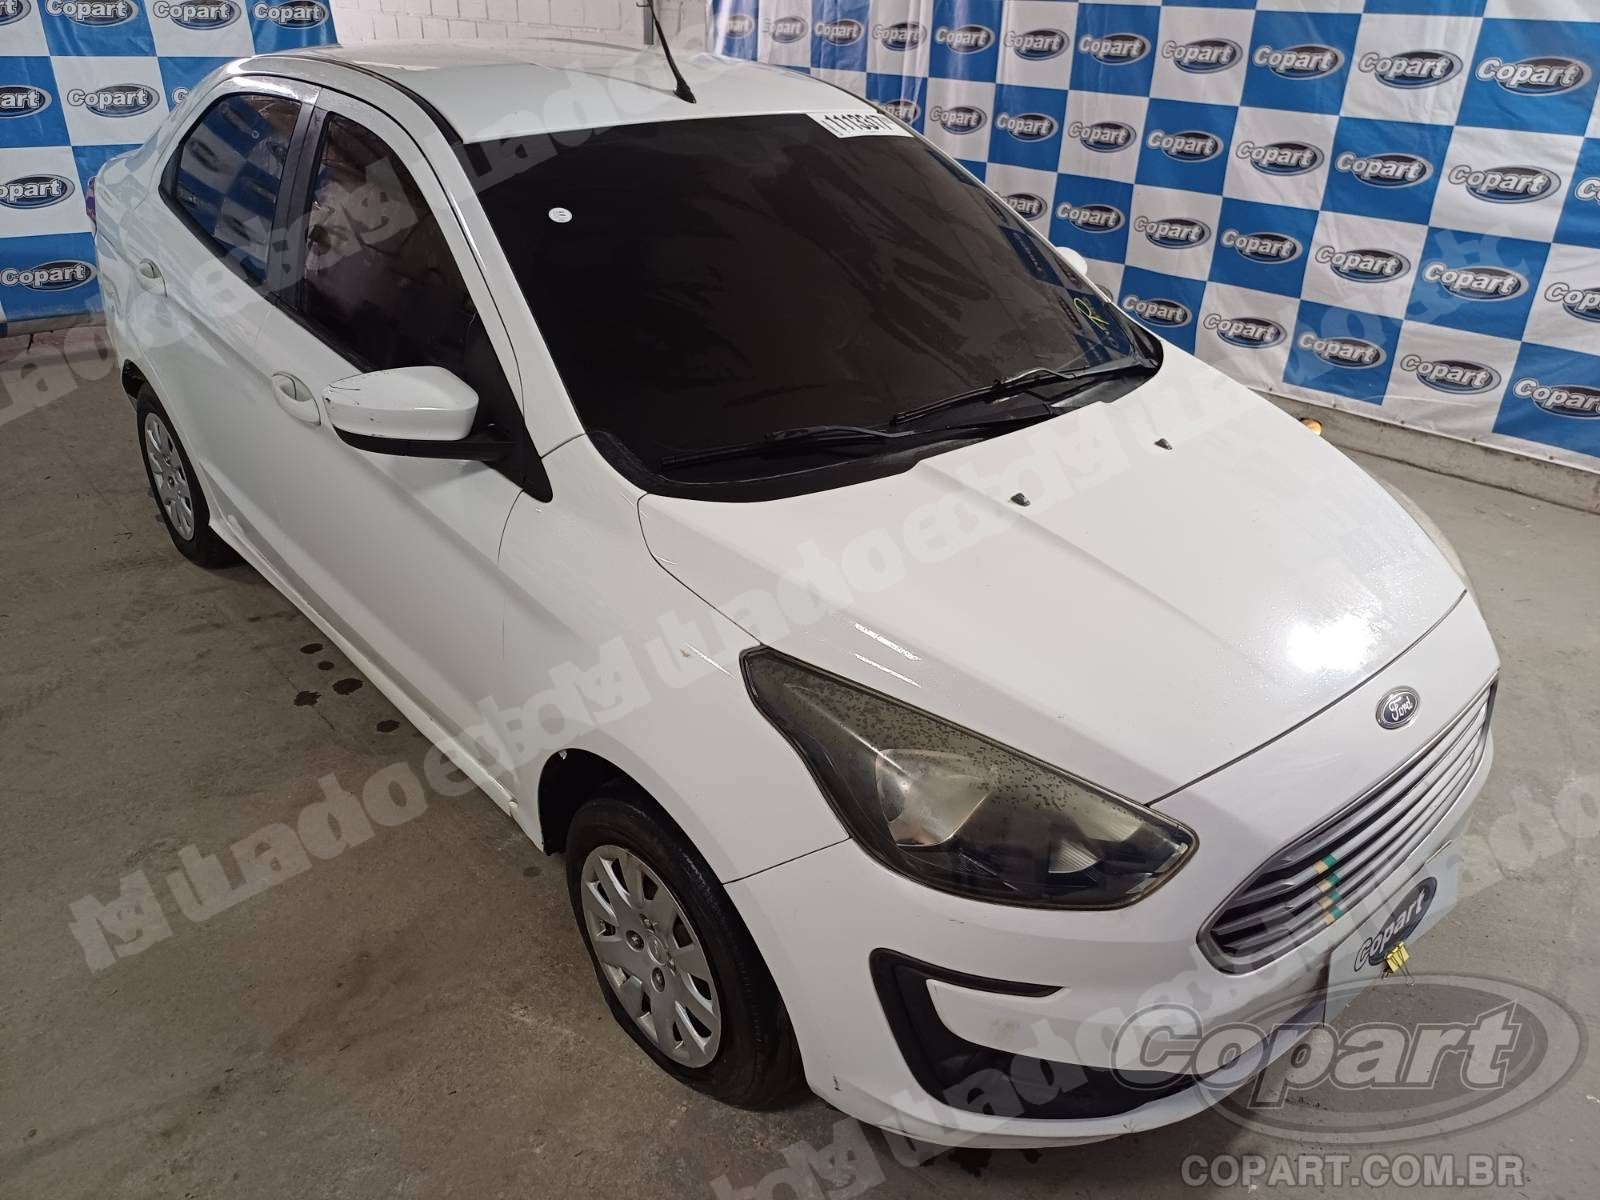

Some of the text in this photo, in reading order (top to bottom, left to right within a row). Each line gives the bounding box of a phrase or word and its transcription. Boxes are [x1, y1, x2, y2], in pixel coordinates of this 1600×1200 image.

[46, 0, 128, 21] Copart
[153, 0, 230, 22] Copart
[254, 3, 321, 24] Copart
[815, 22, 858, 39] Copart
[873, 25, 921, 45] Copart
[935, 28, 988, 49] Copart
[1004, 31, 1061, 51] Copart
[1079, 36, 1143, 57] Copart
[1161, 40, 1231, 64] Copart
[1253, 45, 1332, 72] Copart
[1358, 52, 1447, 79] Copart
[1475, 56, 1581, 87] Copart
[0, 89, 40, 109] art
[67, 88, 147, 110] Copart
[931, 106, 979, 128] Copart
[997, 112, 1051, 137] Copart
[1068, 121, 1128, 145] Copart
[1147, 131, 1216, 156] Copart
[1236, 141, 1313, 167] Copart
[1335, 152, 1421, 181] Copart
[0, 178, 61, 203] opart
[1448, 164, 1550, 194] Copart
[1056, 202, 1117, 227] Copart
[1134, 215, 1200, 242] Copart
[1221, 230, 1292, 258] Copart
[1315, 245, 1400, 275] Copart
[0, 263, 86, 288] Copart
[1422, 262, 1518, 295] Copart
[1122, 295, 1184, 322] Copart
[1203, 313, 1277, 342] Copart
[1298, 331, 1377, 363] Copart
[1401, 354, 1490, 387] Copart
[1387, 697, 1414, 721] Ford
[1354, 890, 1425, 971] Copart
